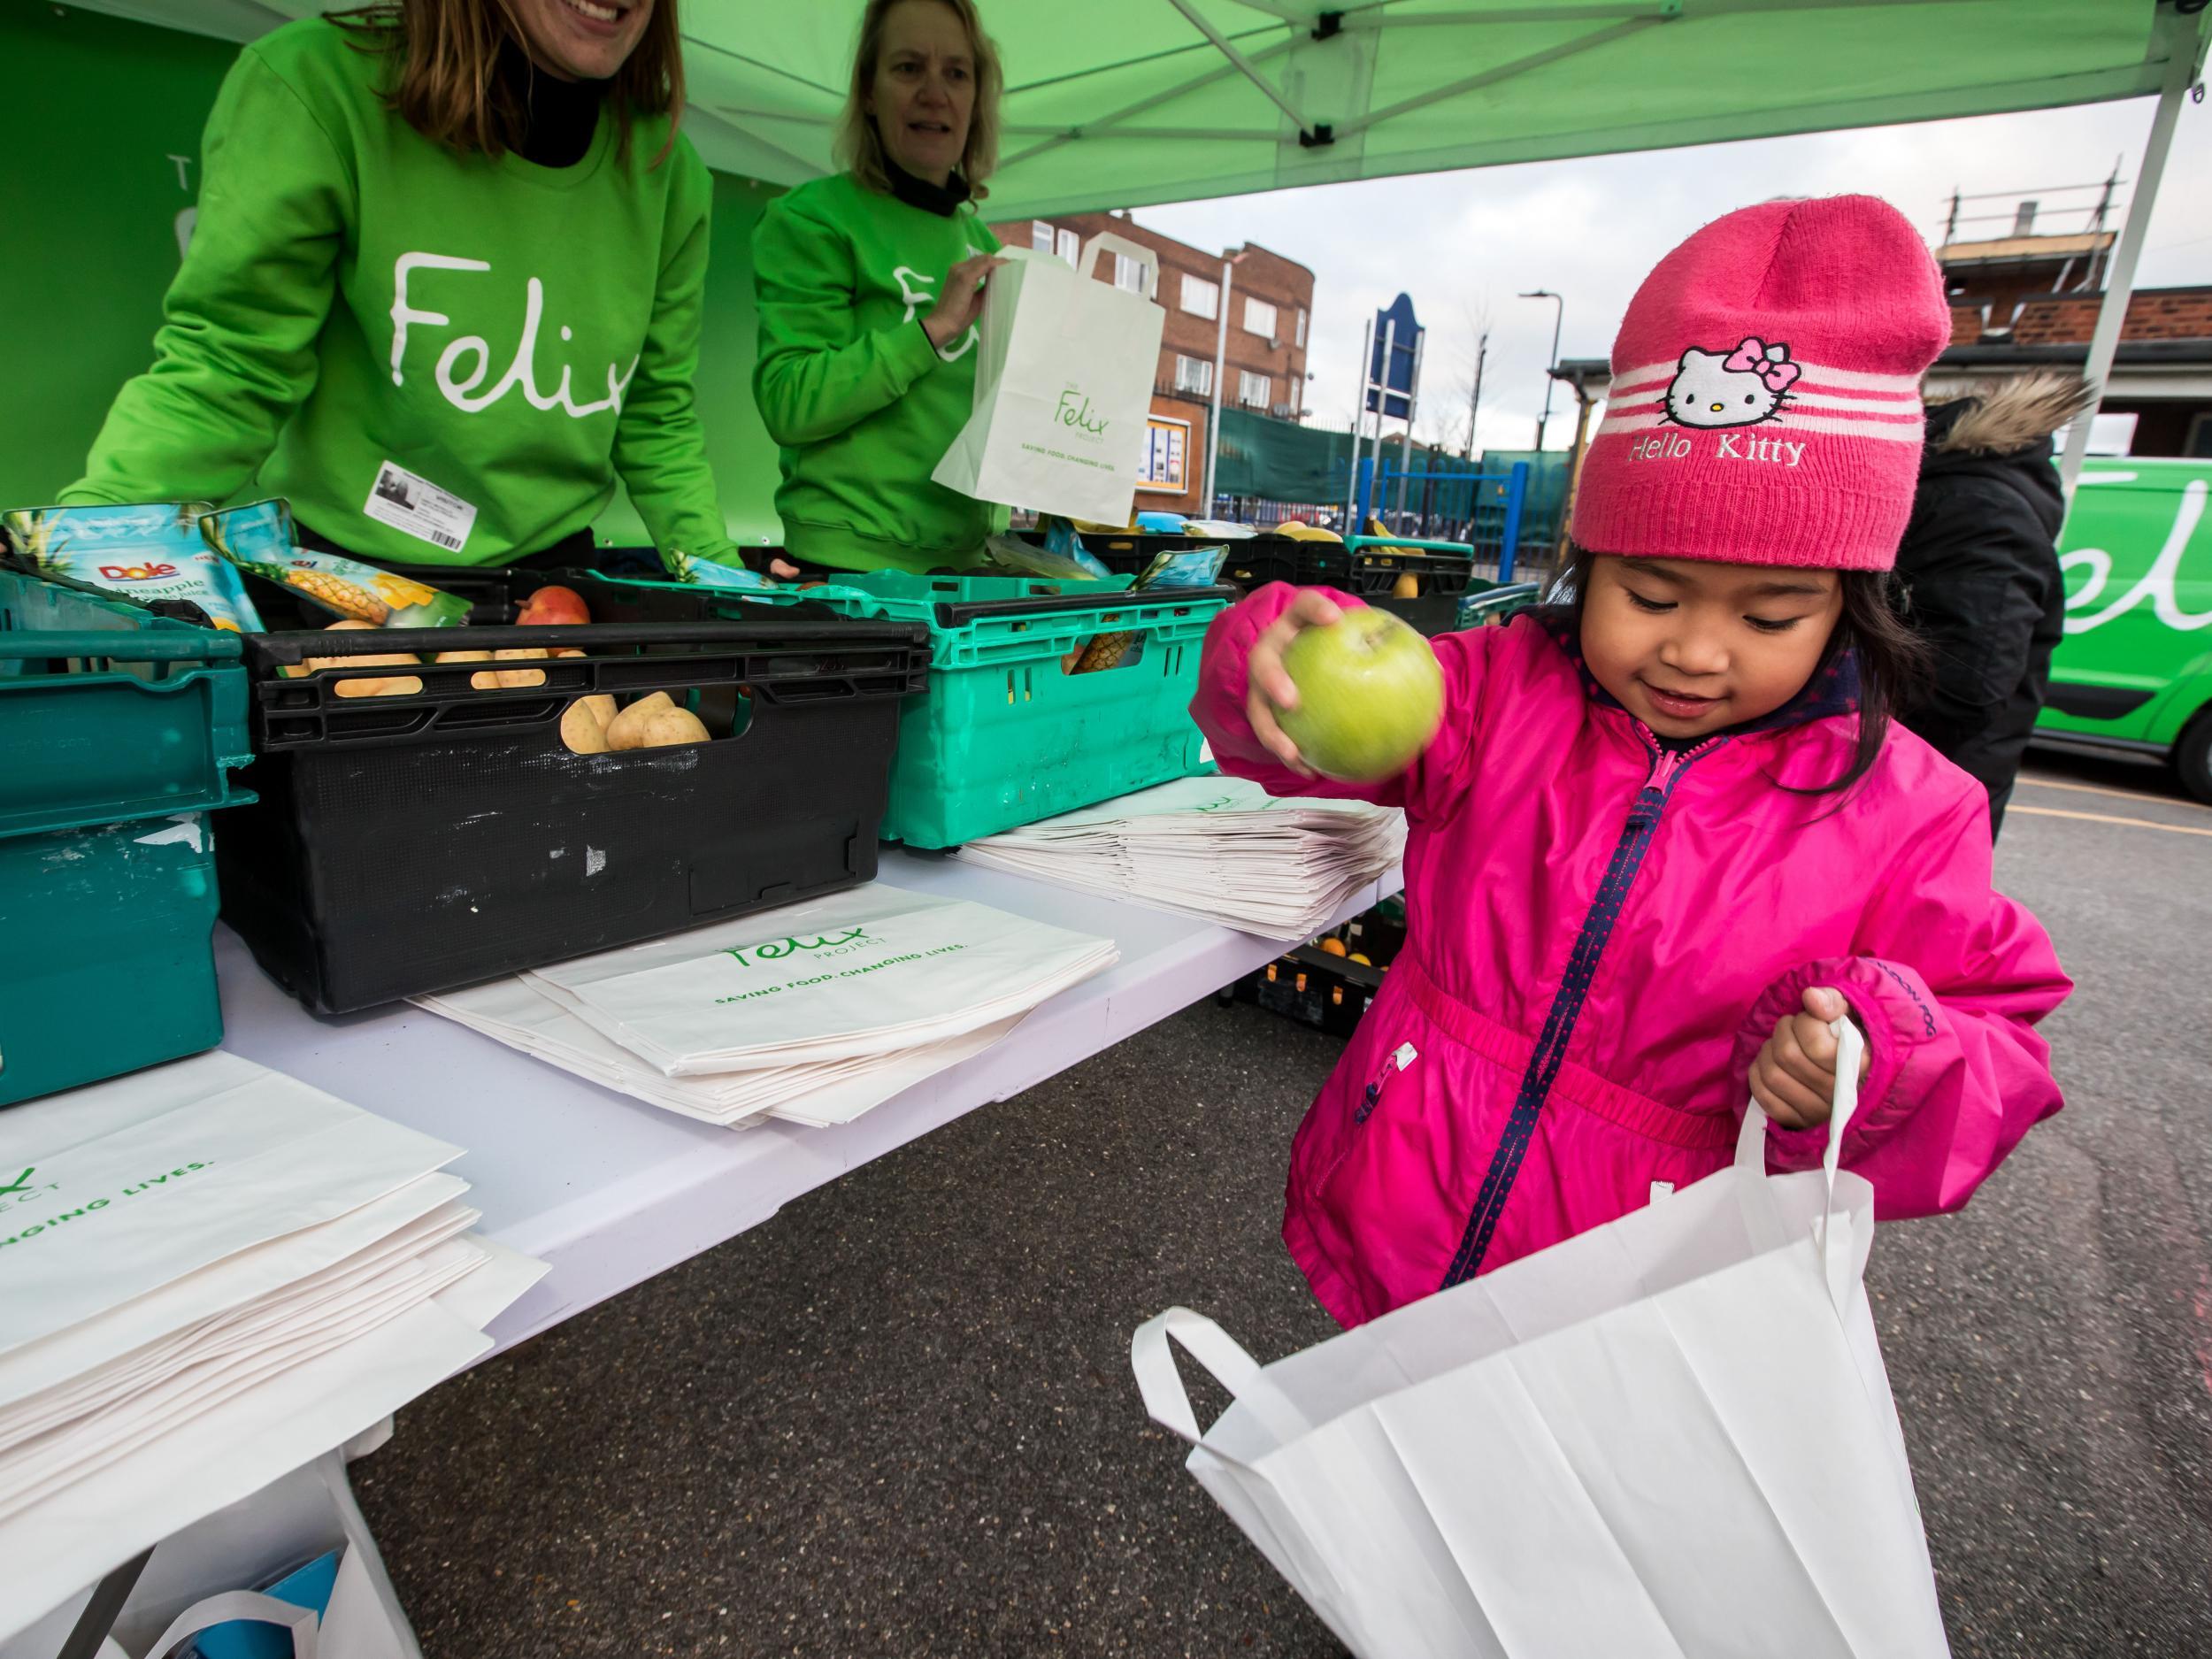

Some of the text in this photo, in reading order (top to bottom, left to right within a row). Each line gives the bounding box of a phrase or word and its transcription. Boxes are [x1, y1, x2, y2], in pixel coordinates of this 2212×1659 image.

[389, 251, 640, 418] Felix
[1055, 390, 1110, 435] Felix
[1628, 431, 1805, 467] Hello Kitty
[98, 562, 176, 580] Dole
[813, 937, 886, 960] PROJECT
[715, 943, 969, 1005] SAVING FOOD. CHANGING LIVES.
[122, 1161, 216, 1196] LIVES.
